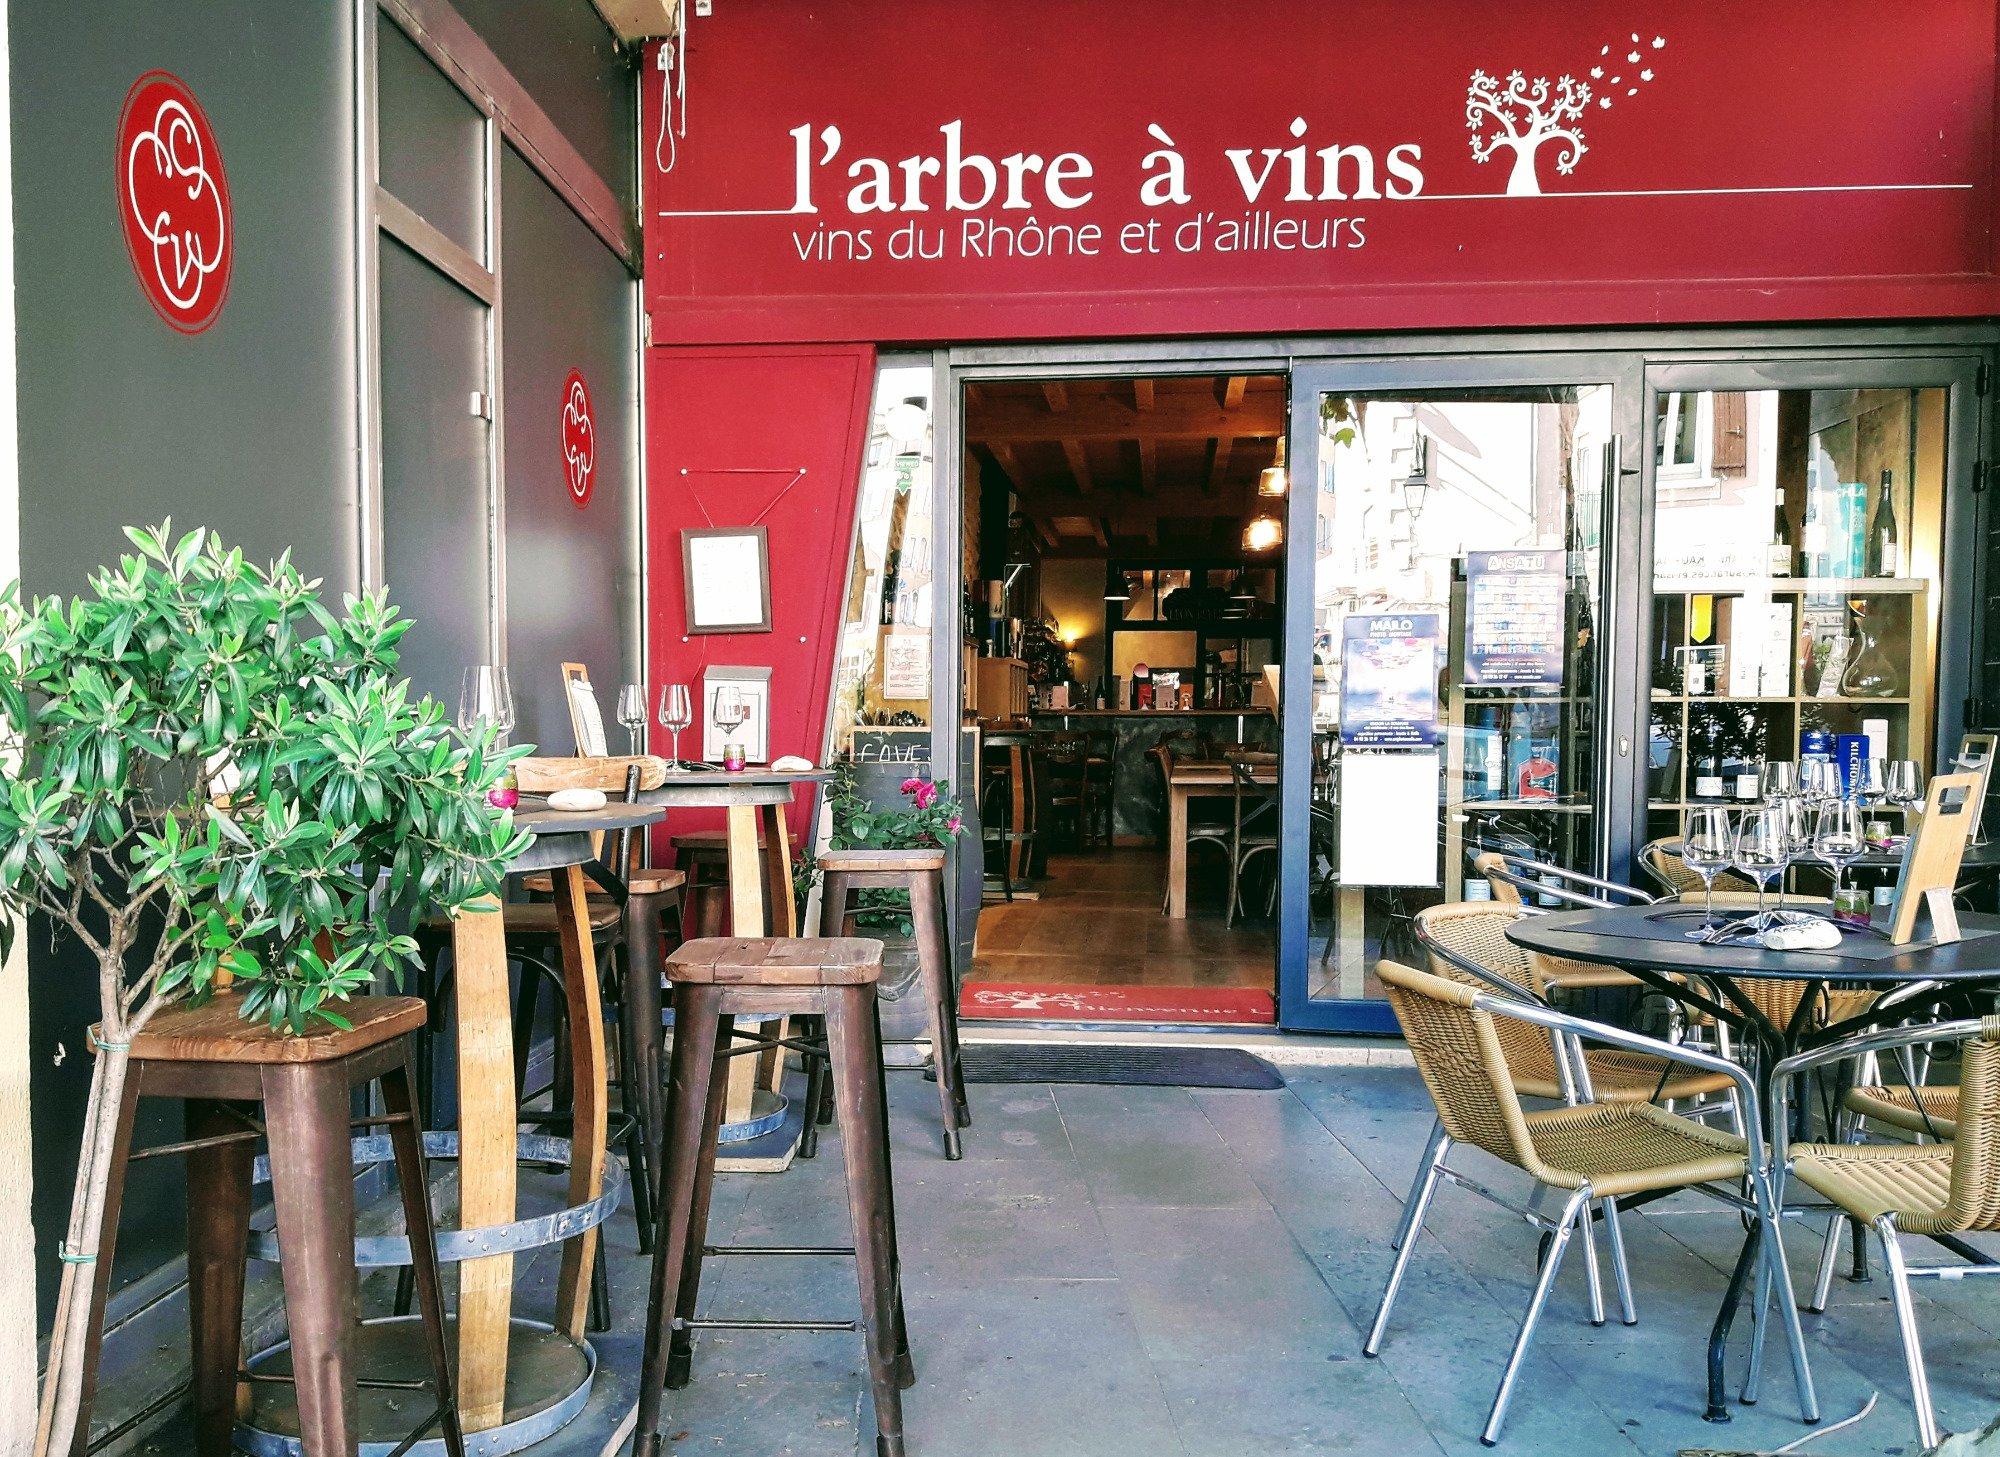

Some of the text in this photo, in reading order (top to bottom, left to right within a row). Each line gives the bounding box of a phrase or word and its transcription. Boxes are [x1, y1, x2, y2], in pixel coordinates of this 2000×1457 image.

[789, 116, 1425, 214] l'arbre à vins
[793, 210, 1367, 262] vins du Rhône et d'ailleurs
[1370, 619, 1414, 632] MALO
